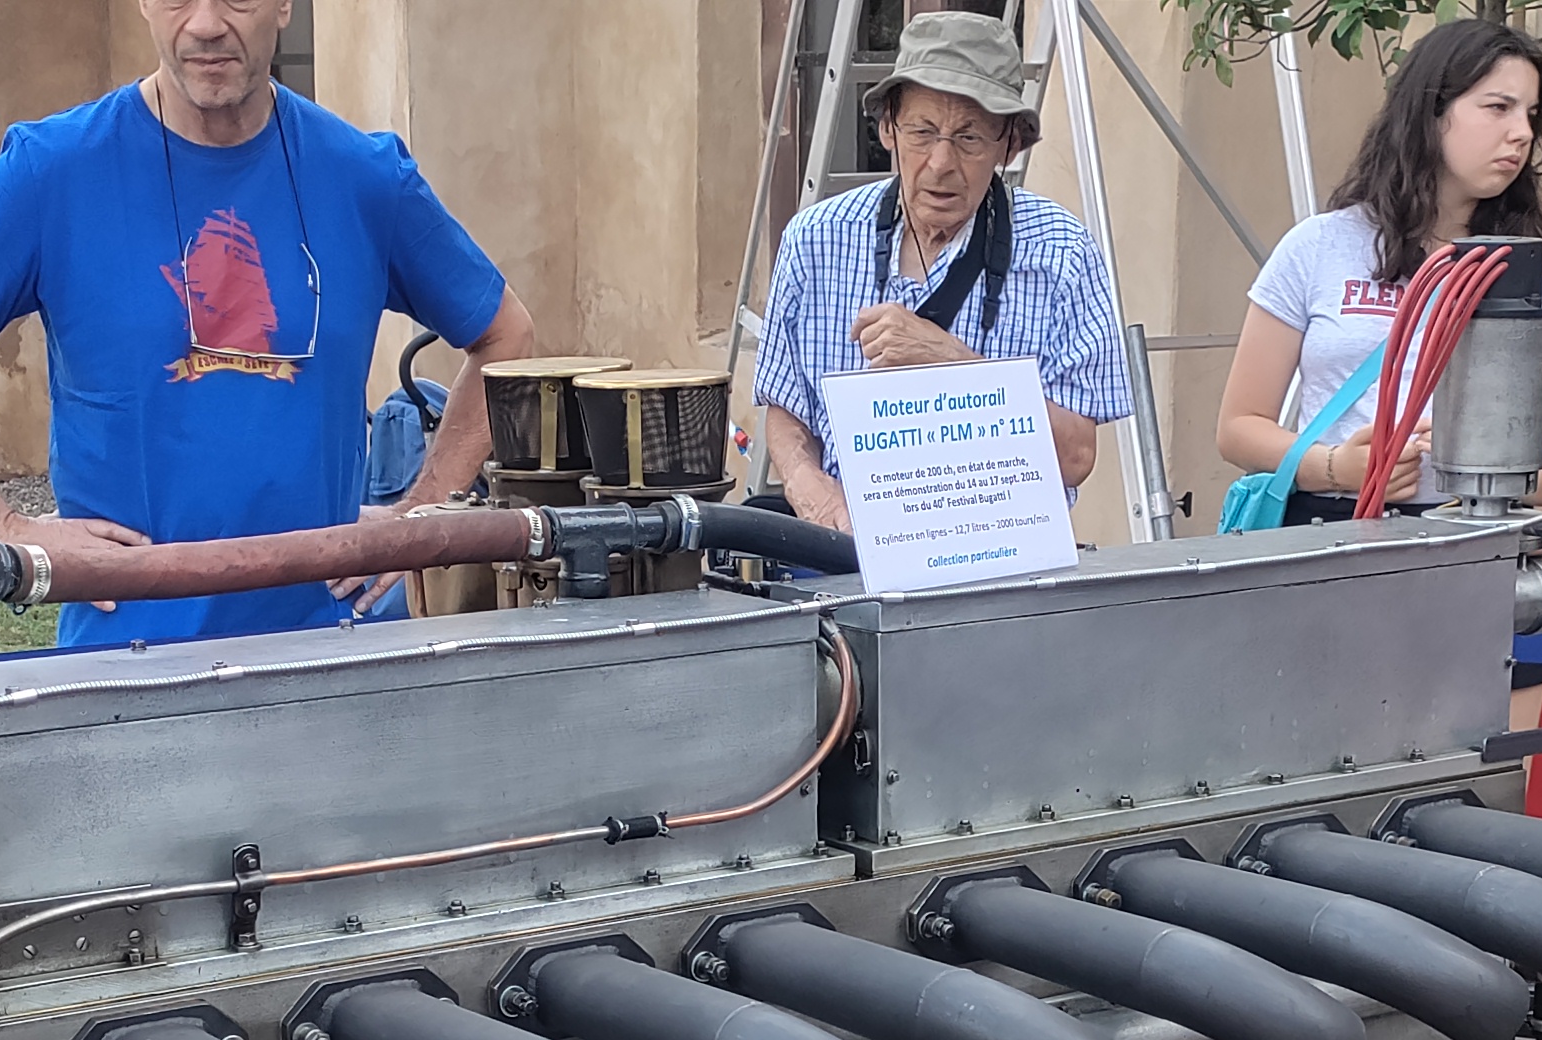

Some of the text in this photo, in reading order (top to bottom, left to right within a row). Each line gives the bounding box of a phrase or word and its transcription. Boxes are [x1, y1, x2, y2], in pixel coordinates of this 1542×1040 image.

[873, 399, 930, 418] Moteur
[854, 428, 922, 452] BUGATTI
[940, 423, 973, 443] PLM
[990, 418, 1005, 437] n°
[1010, 416, 1035, 435] 111
[870, 456, 1029, 484] Ce moteur de 200 ch, en état de marche,
[863, 470, 1043, 502] sera en démonstration du 14 au 17 sept. 2023,
[902, 502, 919, 513] lors
[920, 500, 931, 511] du
[947, 493, 977, 508] Festival
[978, 490, 1006, 505] Bugatti
[875, 535, 880, 545] 8
[882, 532, 915, 546] cylindres
[915, 531, 925, 540] en
[926, 528, 948, 540] lignes
[955, 524, 970, 535] 12,7
[972, 522, 990, 532] litres
[996, 518, 1014, 529] 2000
[1015, 513, 1050, 526] tours/min
[927, 546, 1017, 568] Collection particulière
